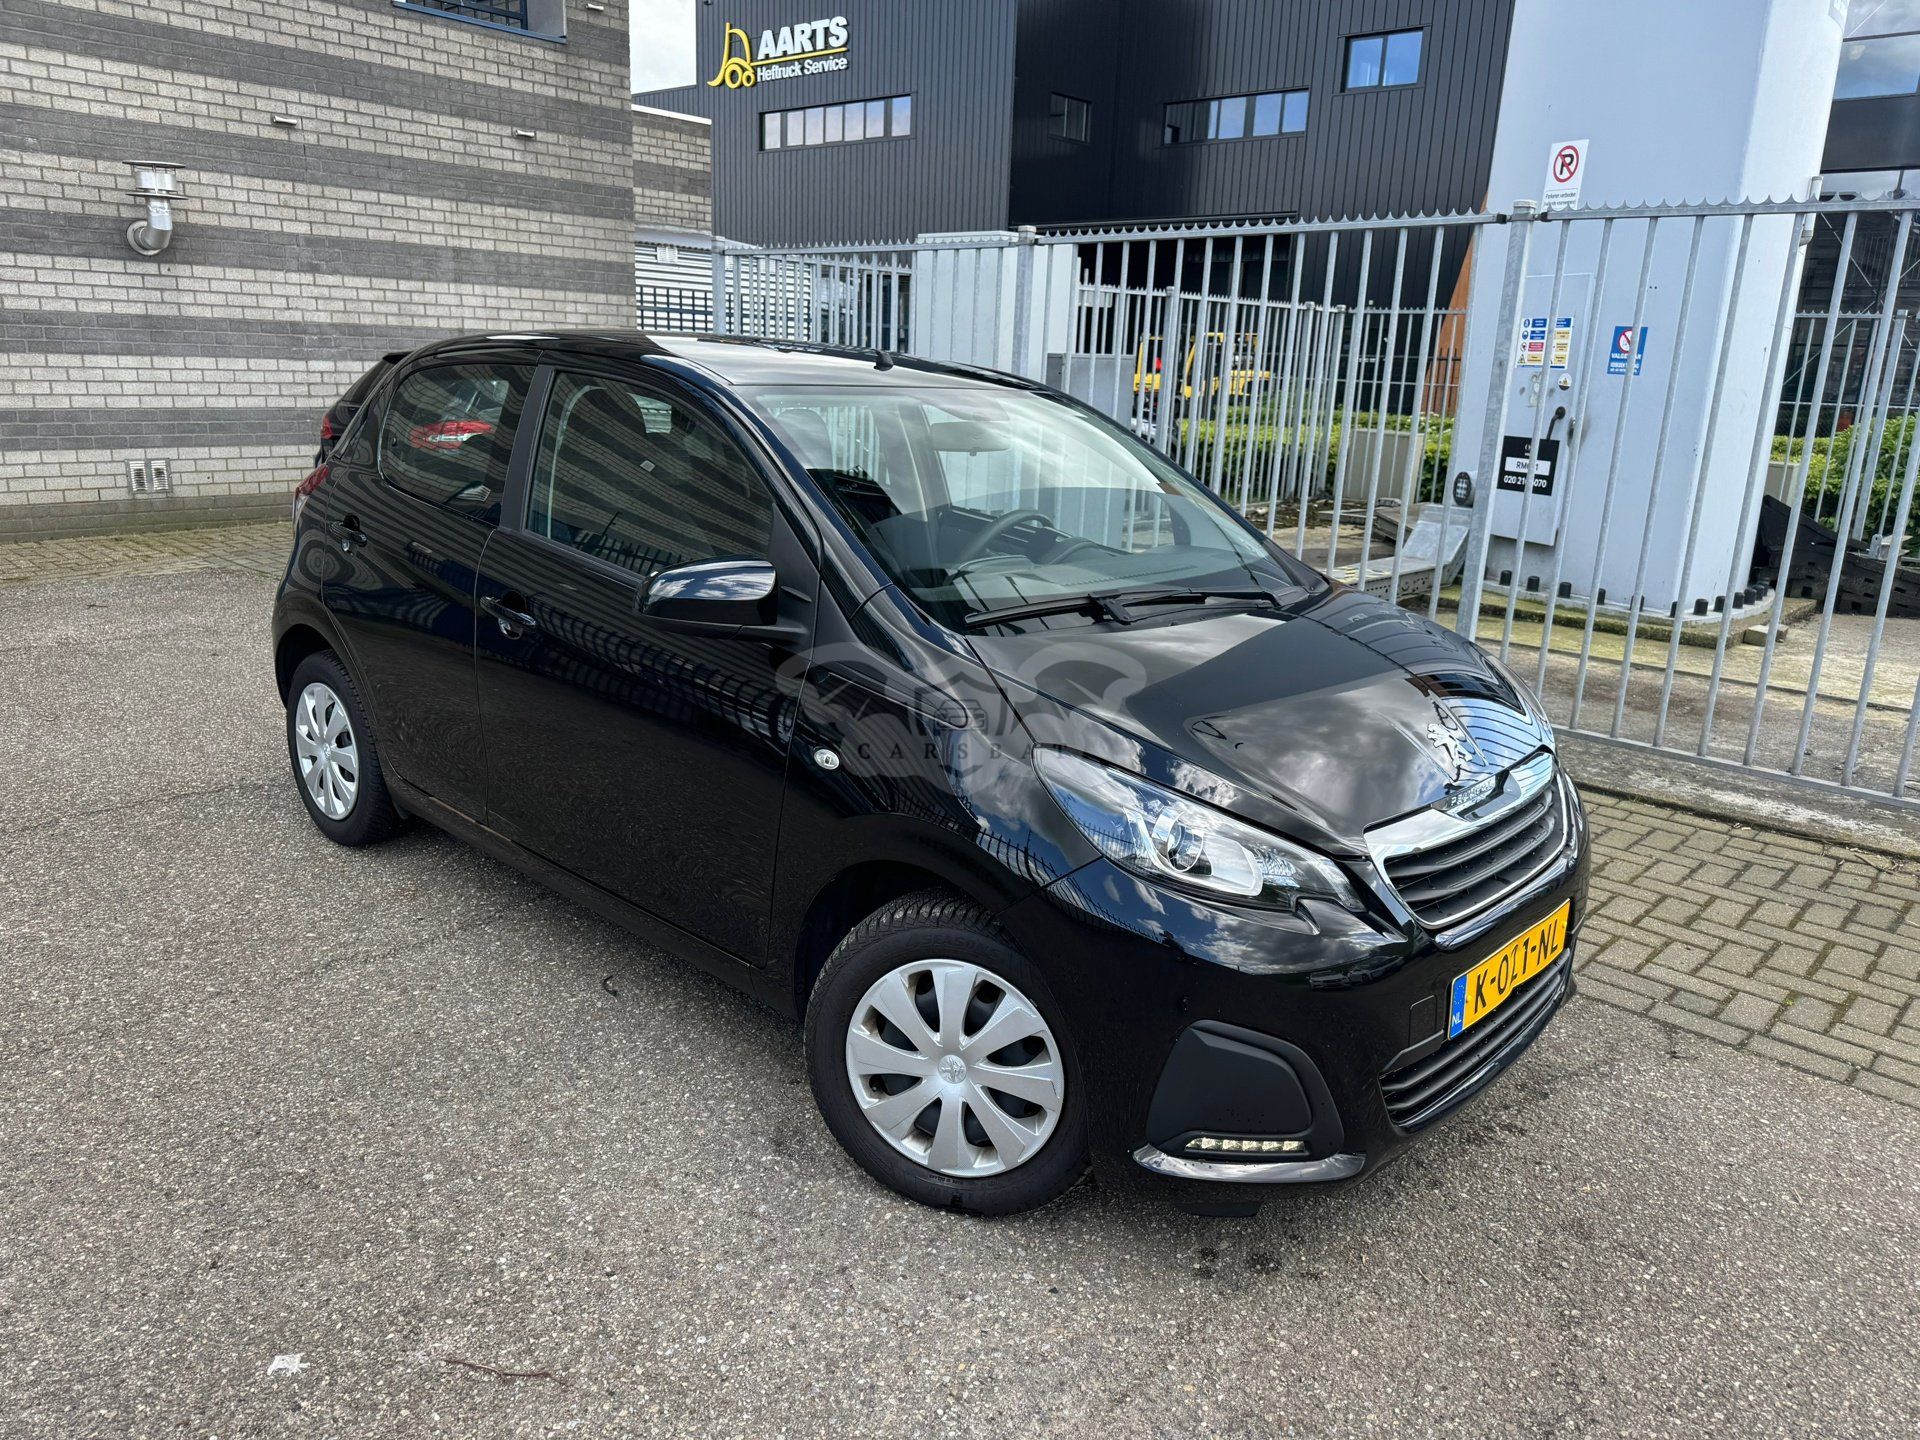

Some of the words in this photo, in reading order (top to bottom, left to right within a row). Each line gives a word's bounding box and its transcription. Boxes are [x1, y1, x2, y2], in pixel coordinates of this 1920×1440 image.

[757, 16, 848, 60] AARTS
[757, 62, 802, 82] Heftruck
[803, 56, 848, 75] Service
[1503, 475, 1517, 485] 020
[1451, 1011, 1462, 1027] NL
